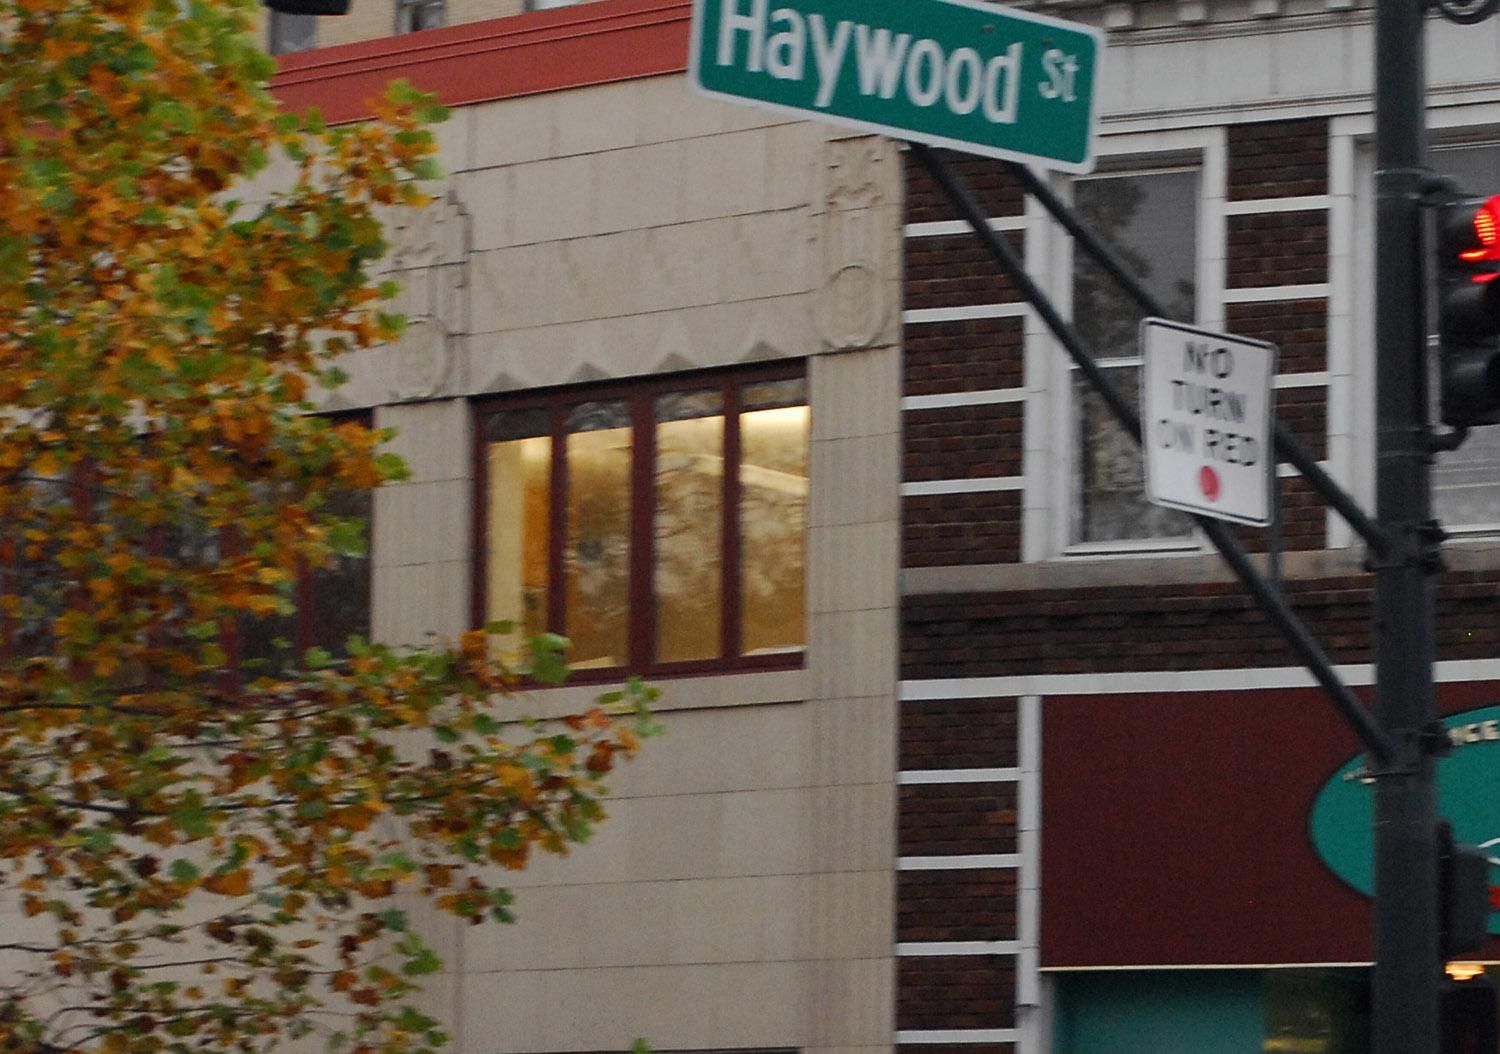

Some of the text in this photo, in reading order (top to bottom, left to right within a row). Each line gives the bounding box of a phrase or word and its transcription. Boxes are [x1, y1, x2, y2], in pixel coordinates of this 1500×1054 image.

[716, 0, 1080, 124] Haywood St
[1184, 341, 1235, 379] NO
[1170, 379, 1246, 424] TURN
[1157, 418, 1260, 467] ON RED
